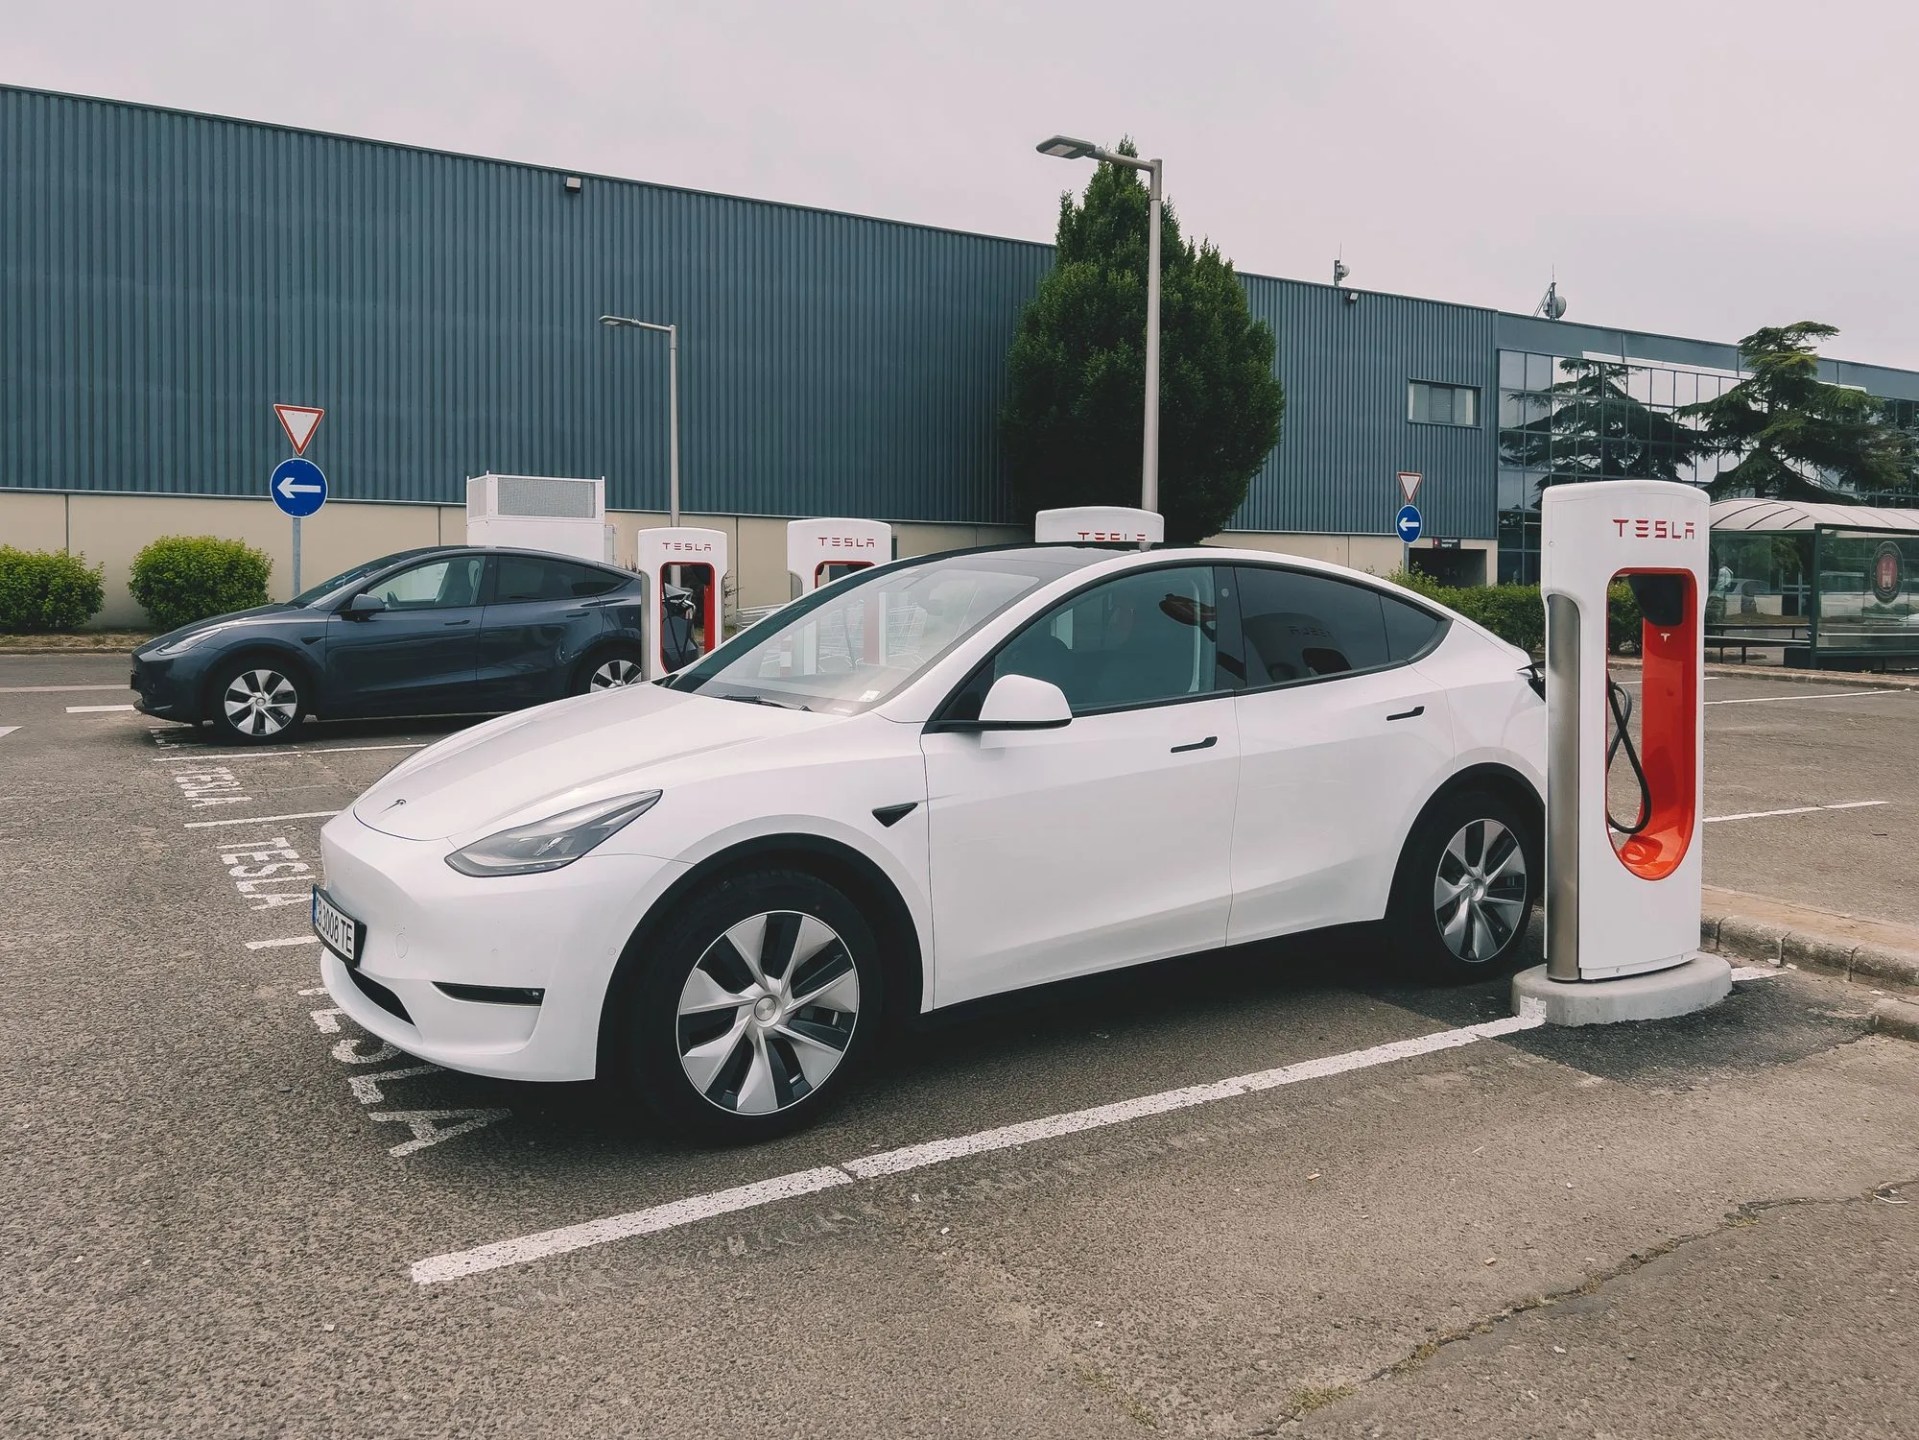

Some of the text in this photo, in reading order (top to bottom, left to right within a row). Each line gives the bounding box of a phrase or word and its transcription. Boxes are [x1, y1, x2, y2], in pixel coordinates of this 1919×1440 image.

[818, 537, 875, 548] TESLA
[1612, 519, 1695, 540] TESLA
[663, 542, 712, 552] TESLA
[174, 767, 252, 808] TESLA
[216, 837, 314, 910] TESLA
[322, 904, 339, 944] 3008
[341, 919, 353, 955] TE
